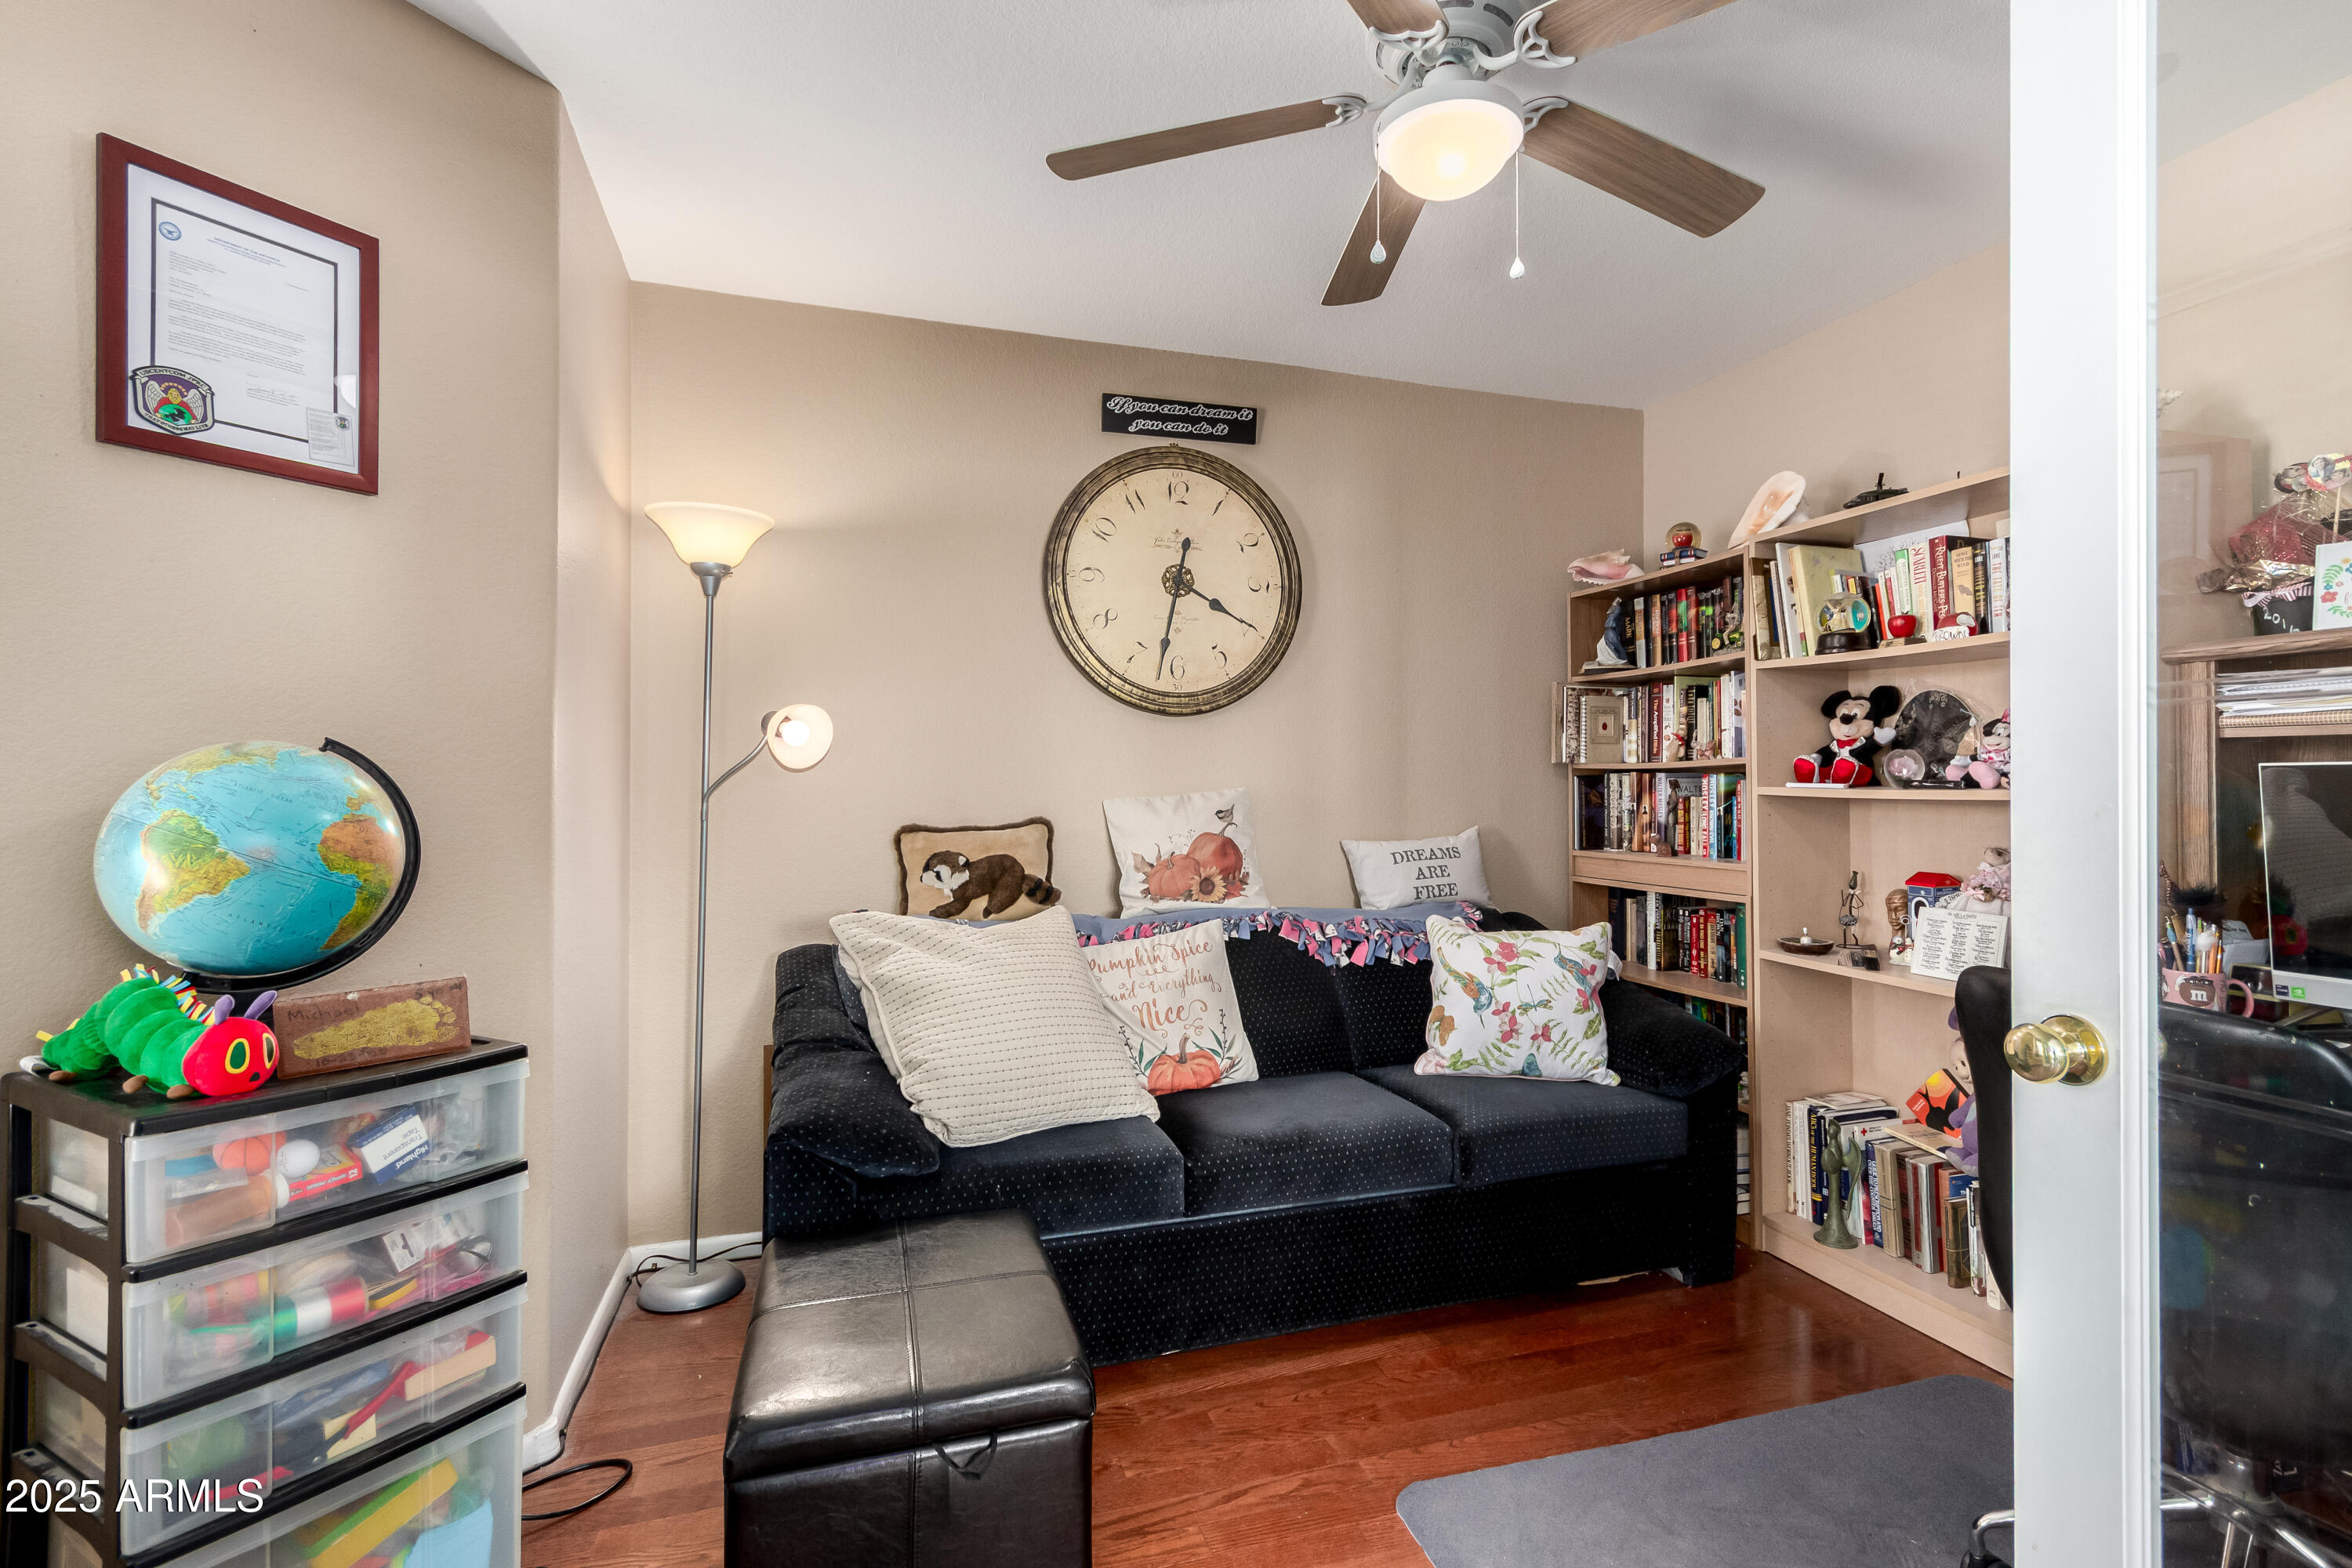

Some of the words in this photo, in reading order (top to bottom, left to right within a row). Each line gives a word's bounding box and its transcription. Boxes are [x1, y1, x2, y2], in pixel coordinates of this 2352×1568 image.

[140, 368, 187, 378] USCENTCOM
[1126, 401, 1160, 415] you
[1159, 404, 1189, 416] can
[1189, 404, 1237, 419] dream
[1237, 408, 1254, 420] it
[1128, 419, 1162, 432] you
[1162, 422, 1192, 433] can
[1192, 422, 1213, 435] do
[1212, 423, 1229, 435] it
[1124, 488, 1145, 514] 11
[1167, 481, 1190, 506] 12
[1212, 499, 1224, 517] 1
[1091, 517, 1117, 543] 10
[1236, 532, 1259, 554] 2
[1910, 546, 1927, 585] SCARLETT
[1934, 546, 1947, 570] RHETT
[1991, 562, 2002, 575] THE
[1078, 566, 1105, 583] 9
[1247, 575, 1270, 594] 3
[1936, 570, 1947, 603] BUTLER'S
[1093, 608, 1119, 630] 8
[1993, 604, 2004, 618] TEN
[1126, 641, 1149, 664] 7
[1211, 642, 1228, 670] 5
[1170, 655, 1185, 681] 6
[1390, 846, 1461, 865] DREAMS
[1415, 865, 1450, 880] ARE
[1413, 883, 1458, 900] FREE
[1087, 943, 1165, 978] Pumpkin
[1171, 939, 1214, 965] Spice
[1110, 981, 1139, 1003] and
[1139, 967, 1222, 999] Everything
[2190, 989, 2208, 1002] m
[287, 1004, 360, 1023] Michael
[1131, 998, 1208, 1039] Nice
[402, 1127, 420, 1139] Tape
[382, 1134, 423, 1161] Transparent
[394, 1144, 429, 1171] Highland
[348, 1167, 358, 1179] 12
